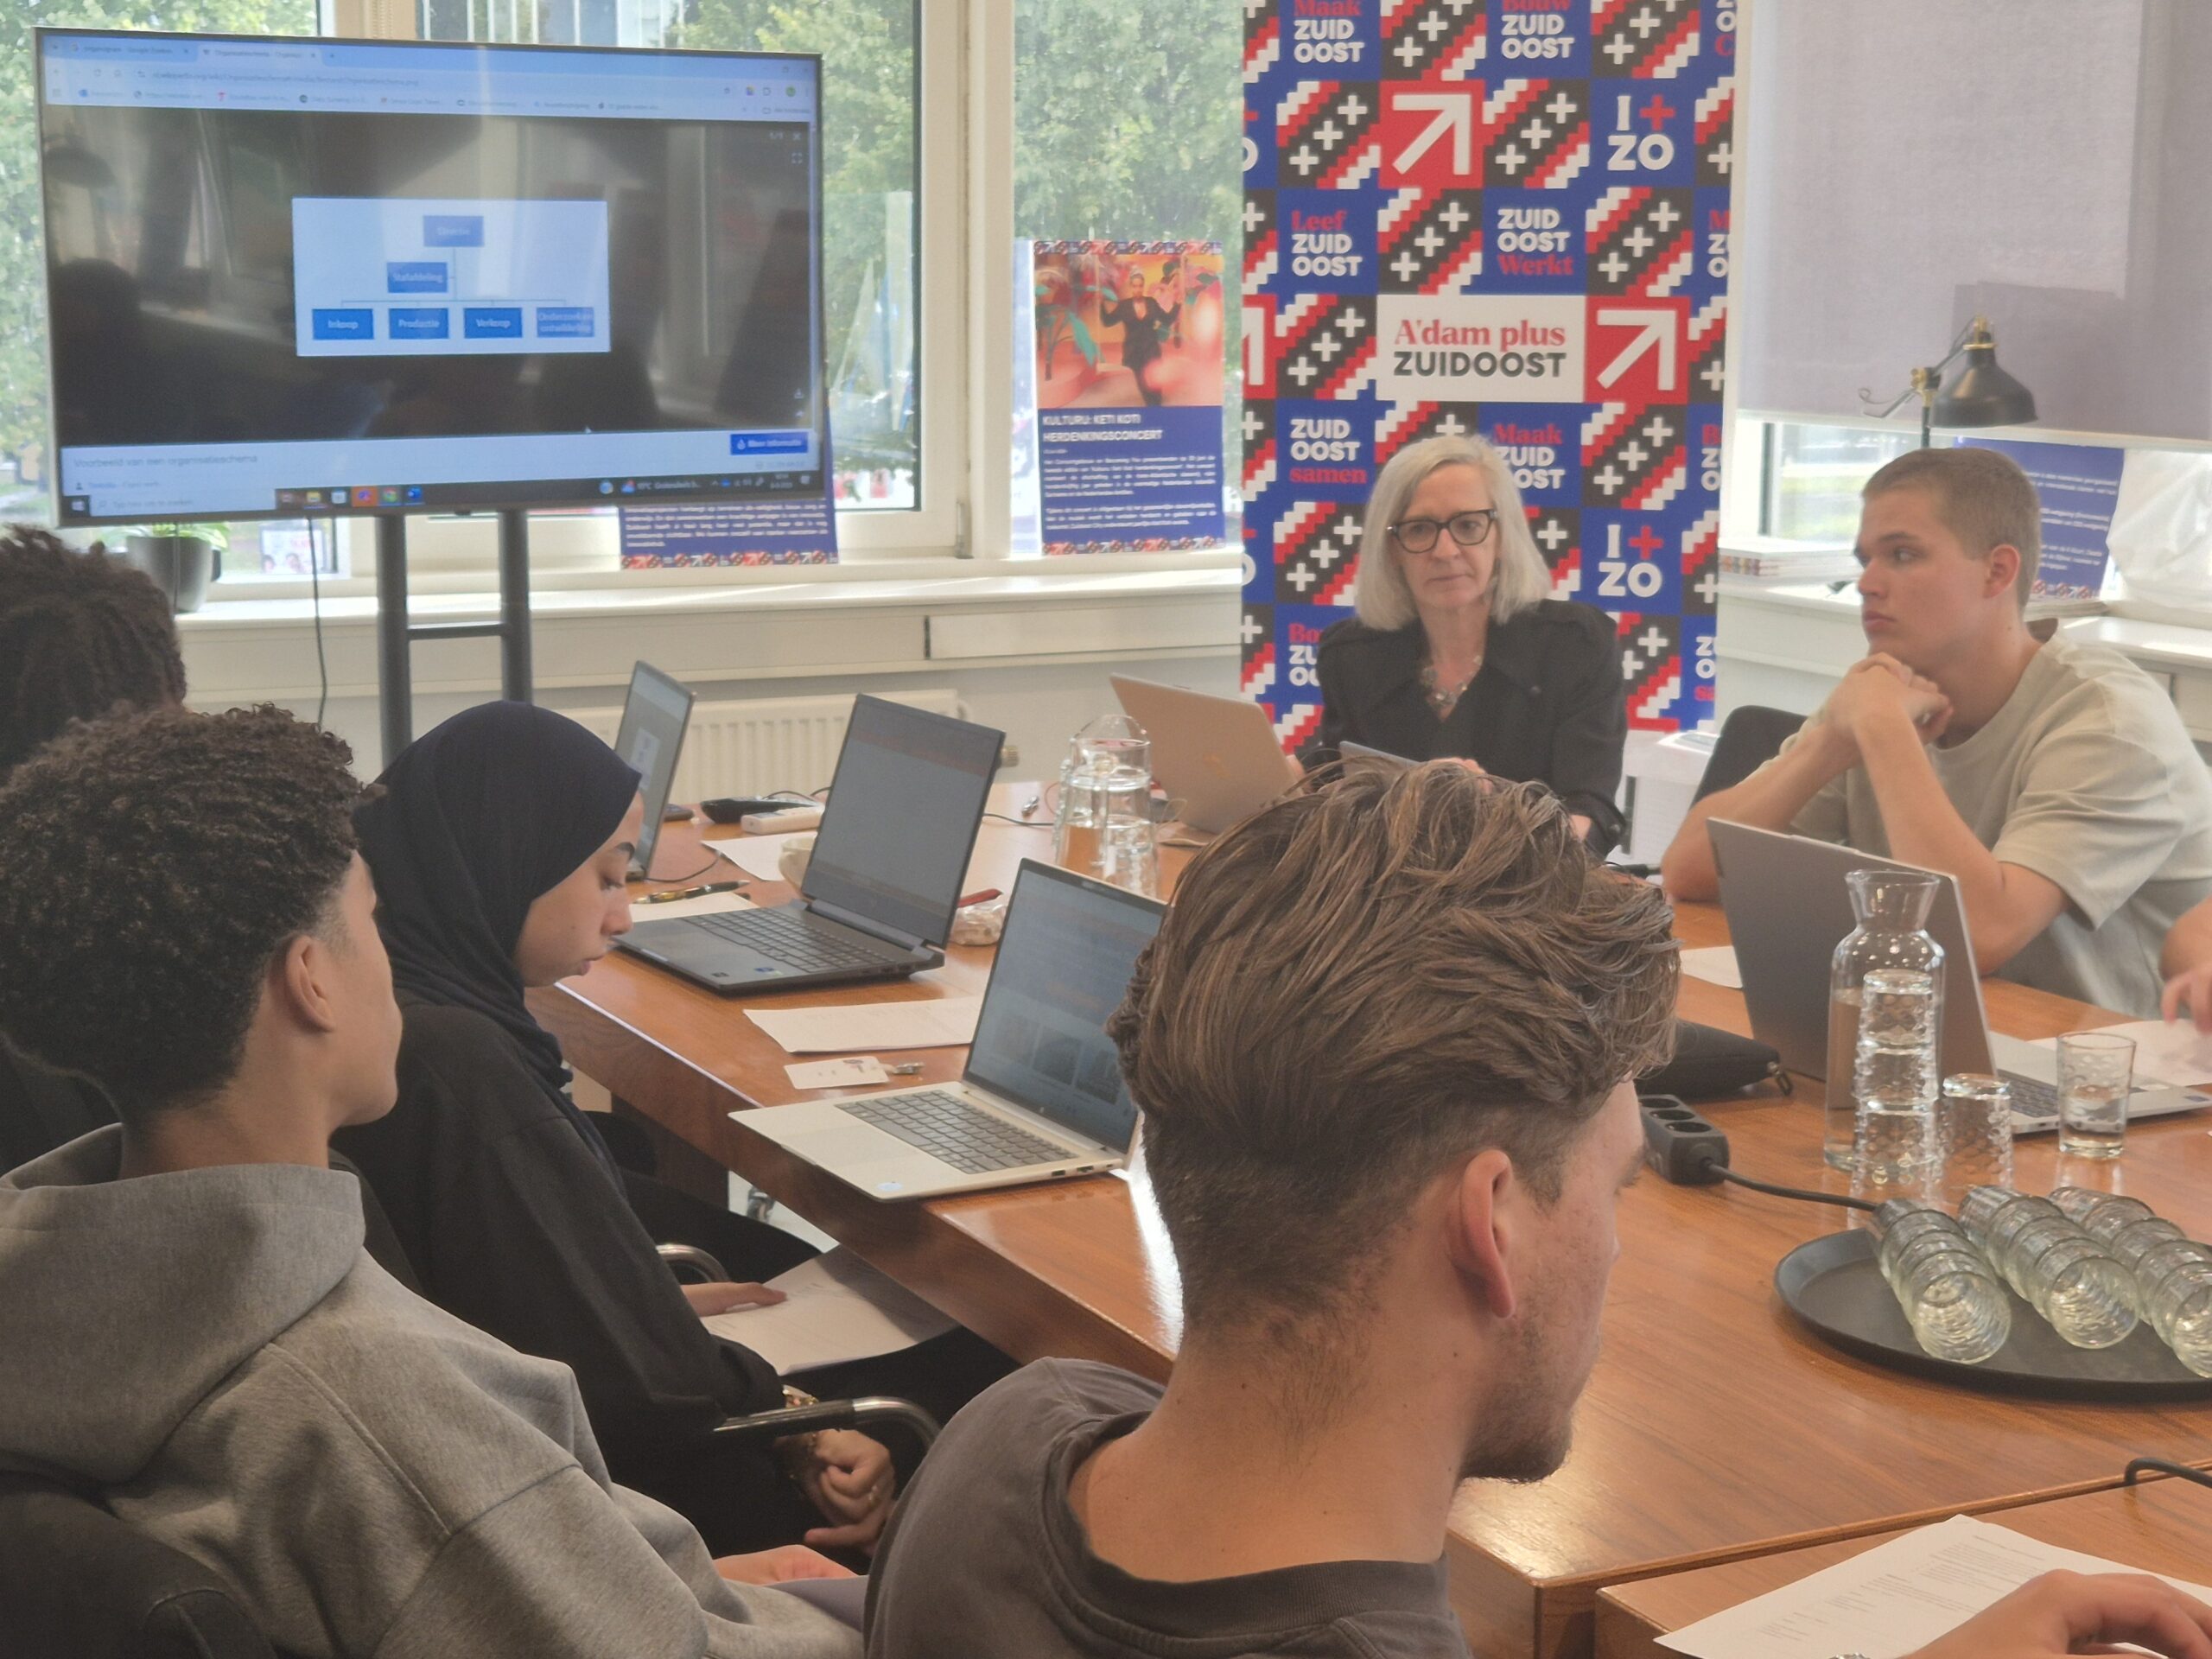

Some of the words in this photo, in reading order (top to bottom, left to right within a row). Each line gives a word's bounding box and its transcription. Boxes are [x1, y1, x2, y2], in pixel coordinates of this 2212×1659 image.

[1294, 19, 1355, 40] ZUID
[1501, 14, 1565, 35] ZUID
[1294, 42, 1364, 63] OOST
[1501, 37, 1574, 59] OOST
[1607, 133, 1675, 171] ZO
[1291, 211, 1347, 231] Leef
[1497, 208, 1560, 230] ZUID
[1292, 233, 1352, 254] ZUID
[1497, 232, 1571, 252] OOST
[1292, 256, 1363, 276] OOST
[1497, 255, 1574, 276] Werkt
[327, 318, 359, 330] Inkoop
[398, 318, 440, 329] Productie
[476, 318, 511, 329] Verkoop
[1394, 319, 1491, 346] A'dam
[1500, 319, 1566, 353] plus
[1393, 351, 1567, 378] ZUIDOOST
[1290, 418, 1351, 439] ZUID
[1493, 423, 1563, 445] Maak
[1290, 441, 1361, 461] OOST
[73, 457, 124, 468] Voorbeeld
[1290, 467, 1367, 484] samen
[1514, 468, 1566, 490] OST
[1599, 562, 1662, 598] ZO
